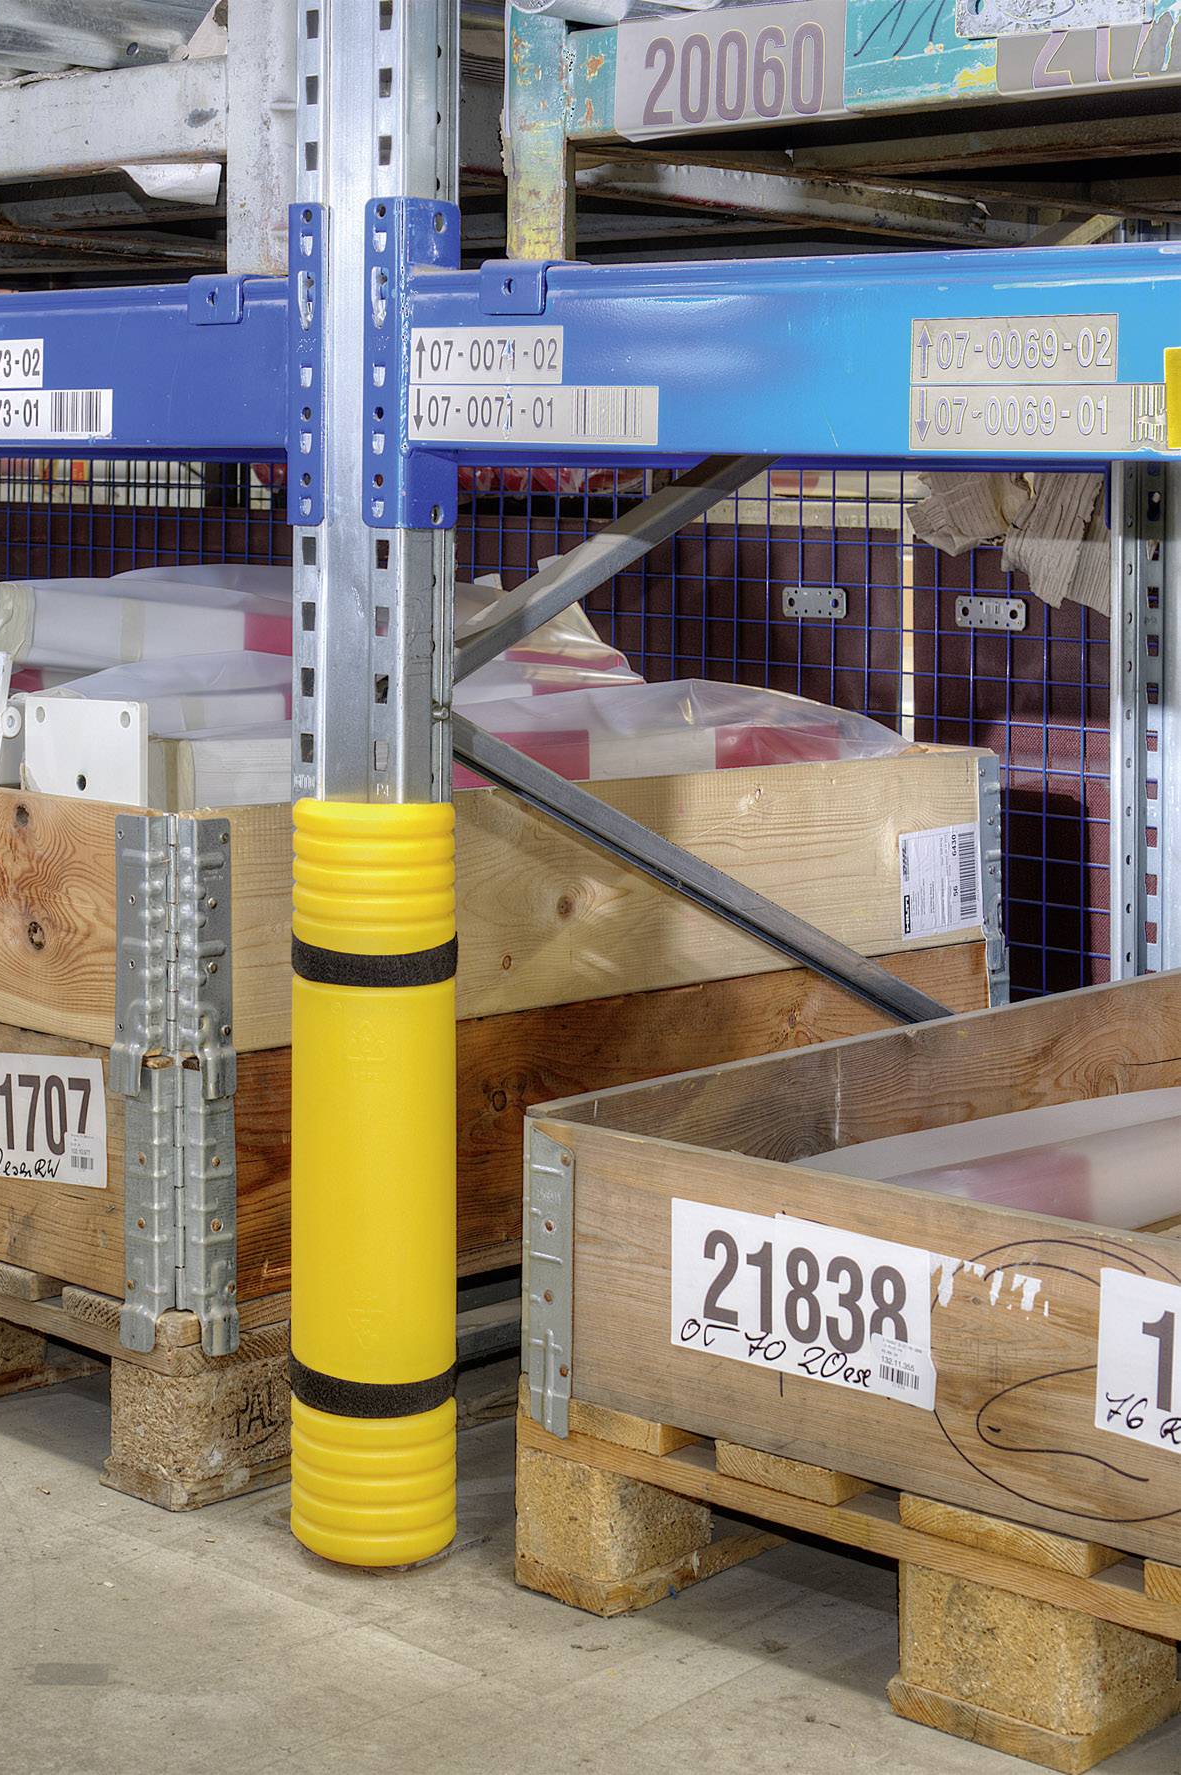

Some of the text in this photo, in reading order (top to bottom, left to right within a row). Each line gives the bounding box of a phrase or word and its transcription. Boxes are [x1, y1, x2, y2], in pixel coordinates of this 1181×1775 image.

[643, 22, 826, 126] 20060
[430, 338, 558, 371] 07-0071-02
[936, 326, 1112, 369] 07-0069-02
[427, 395, 554, 428] 07-0071-01
[935, 395, 1108, 435] 07-0069-01
[702, 1229, 909, 1354] 21838
